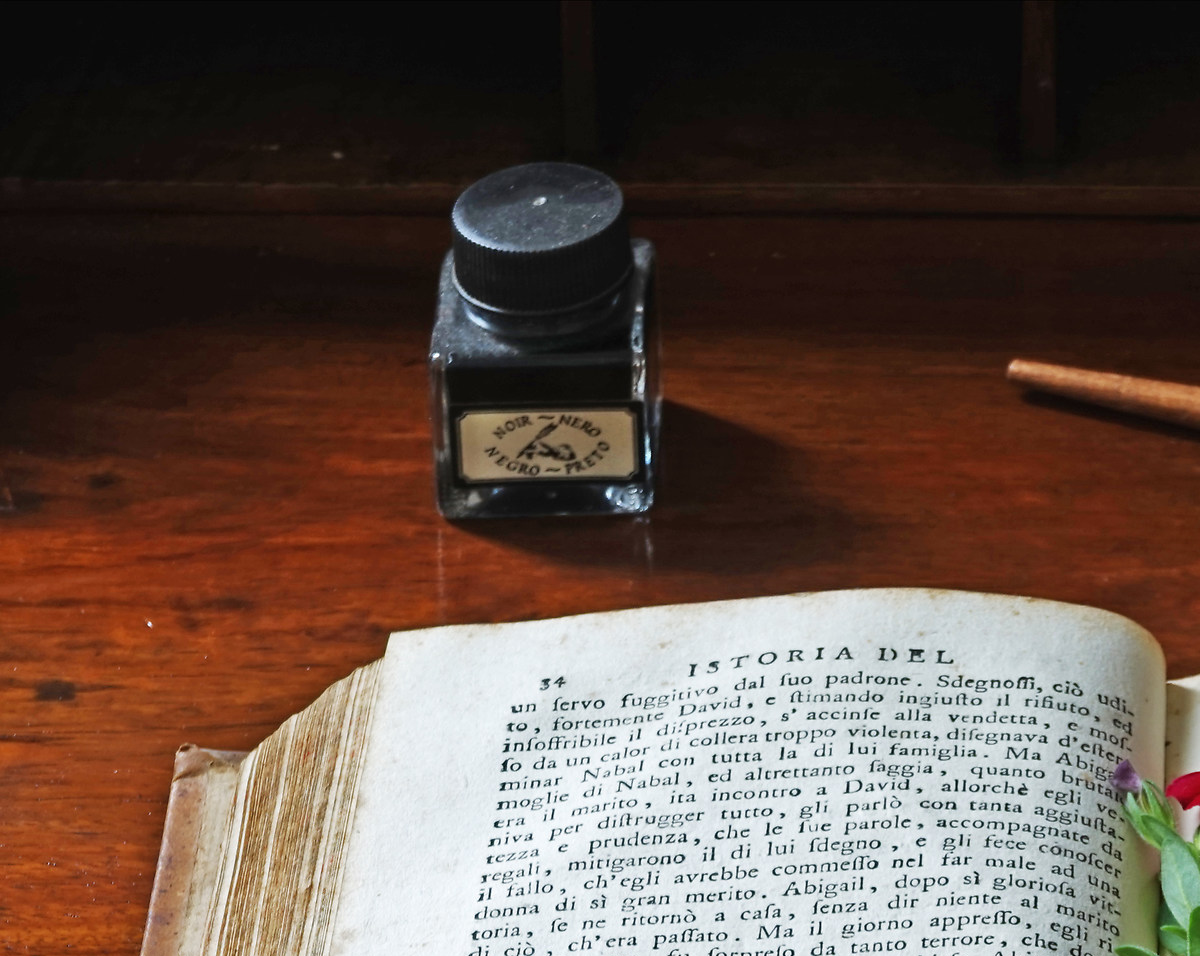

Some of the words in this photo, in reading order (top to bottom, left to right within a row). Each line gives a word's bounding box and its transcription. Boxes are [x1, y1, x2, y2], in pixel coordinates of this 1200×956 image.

[492, 415, 533, 439] NOIR
[559, 414, 601, 437] NERO
[484, 446, 540, 476] NEGRO
[565, 441, 610, 474] PRETO
[540, 676, 566, 690] 34
[688, 647, 853, 677] ISTORIA
[878, 648, 954, 664] DEL
[511, 704, 536, 713] un
[621, 688, 719, 710] fuggitivo
[734, 676, 764, 690] dal
[1053, 681, 1083, 696] ciò
[1098, 694, 1134, 716] udi-
[553, 713, 664, 731] fortemente
[601, 747, 646, 762] calor
[690, 732, 757, 747] collera
[499, 777, 562, 791] minar
[580, 760, 644, 782] Nabal
[712, 753, 762, 764] tutta
[496, 792, 568, 810] moglie
[745, 766, 854, 780] altrettanto
[971, 767, 1045, 779] quanto
[712, 788, 801, 801] incontro
[941, 779, 1028, 795] allorchè
[1044, 790, 1080, 805] egli
[488, 833, 533, 847] niva
[846, 796, 902, 817] parlò
[970, 801, 1022, 813] tanta
[936, 816, 1091, 844] accompagnate
[569, 854, 685, 873] mitigarono
[674, 866, 758, 884] avrebbe
[986, 856, 1035, 870] male
[475, 905, 539, 920] donna
[622, 895, 669, 914] gran
[895, 875, 949, 892] dopo
[622, 909, 696, 926] ritornò
[936, 892, 1001, 906] niente
[1056, 902, 1121, 938] marito
[842, 920, 913, 938] giorno
[851, 941, 906, 953] tanto
